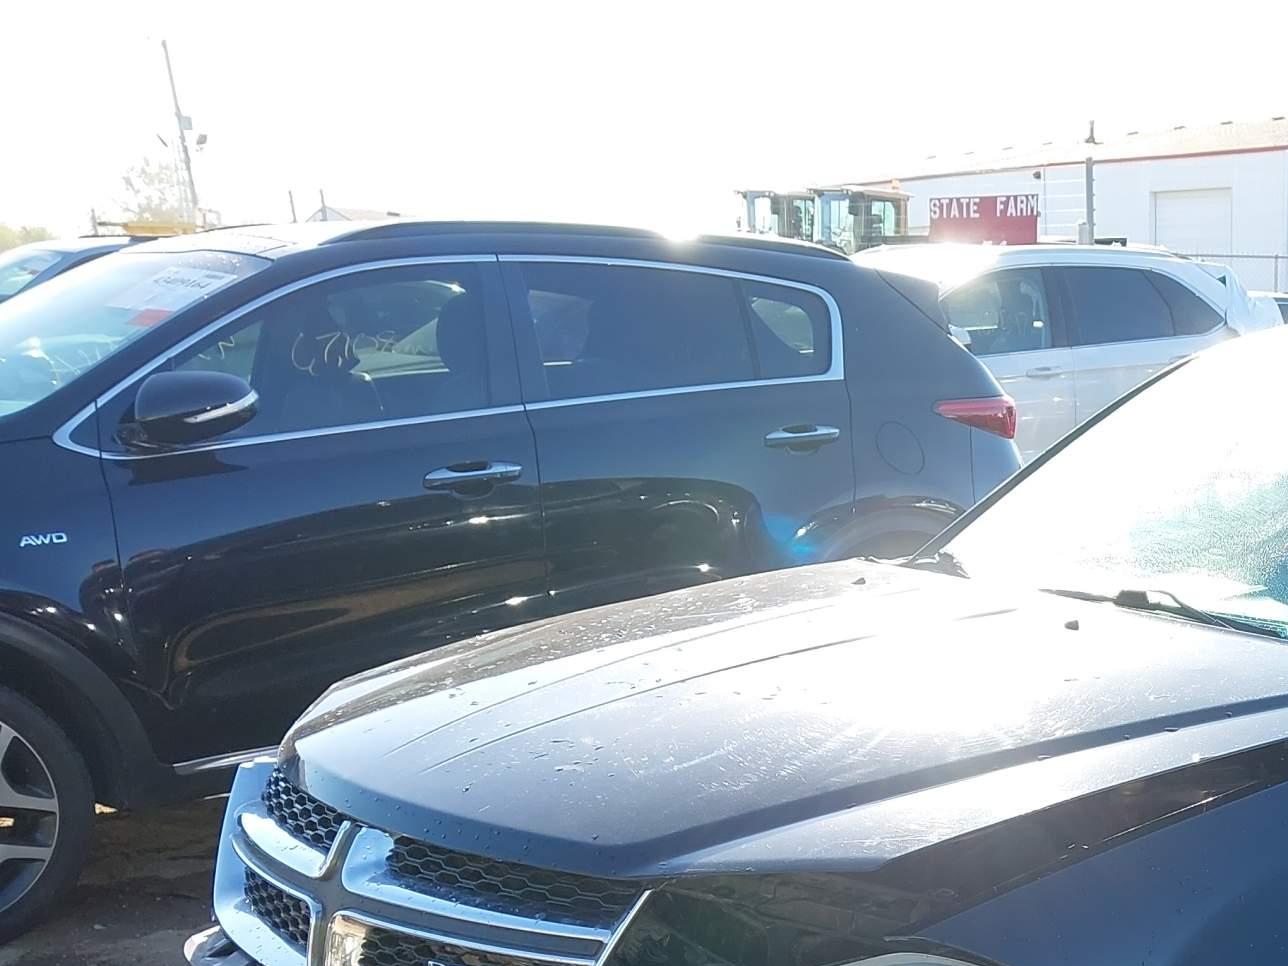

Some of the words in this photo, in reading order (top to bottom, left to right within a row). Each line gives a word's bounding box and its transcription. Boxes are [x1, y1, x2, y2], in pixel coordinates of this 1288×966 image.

[930, 198, 980, 219] STATE
[996, 195, 1037, 217] FARM
[19, 532, 68, 547] AWD
